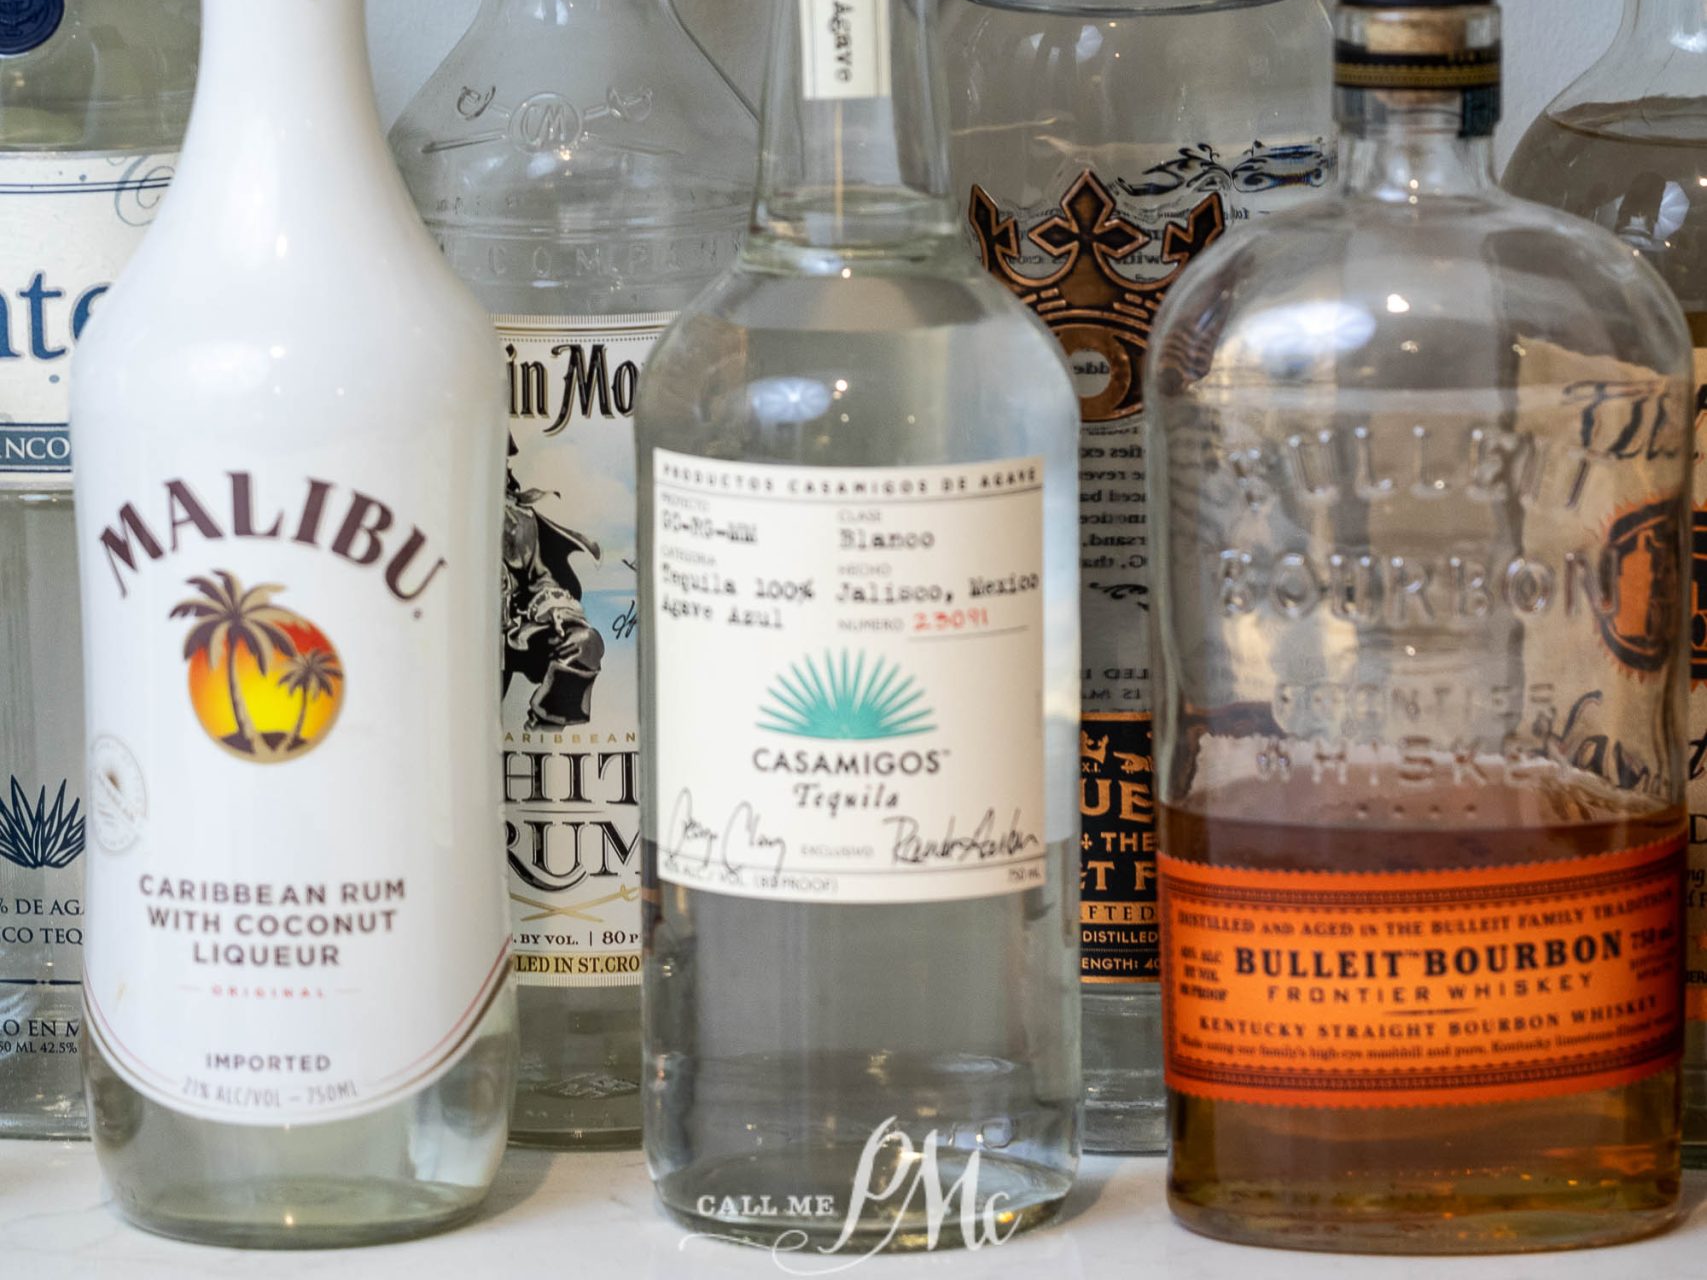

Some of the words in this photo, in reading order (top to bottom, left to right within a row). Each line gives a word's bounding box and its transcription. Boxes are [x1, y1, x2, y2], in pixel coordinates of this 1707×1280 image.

[0, 436, 70, 460] NCO
[787, 479, 928, 498] CASAMIGOS
[940, 475, 966, 493] DE
[98, 469, 449, 602] MALIBU
[839, 528, 936, 550] Blanco
[662, 562, 737, 596] Tequila
[755, 577, 816, 604] 100%
[836, 581, 955, 603] Jalisco,
[968, 572, 1040, 599] Mexico
[1216, 550, 1622, 624] BOURBON
[661, 595, 713, 619] Agave
[913, 607, 989, 632] 23091
[504, 731, 636, 745] ARIBBEAN
[751, 746, 942, 776] CASAMIGOS
[792, 782, 900, 819] Tequila
[1100, 831, 1157, 853] THE
[138, 873, 328, 907] CARIBBEAN
[340, 878, 407, 903] RUM
[15, 898, 44, 916] DE
[49, 898, 85, 916] AG
[1081, 904, 1155, 922] FTED
[146, 906, 222, 935] WITH
[233, 909, 398, 938] COCONUT
[1178, 911, 1255, 934] DISTILLED
[1262, 921, 1295, 935] AND
[1300, 921, 1354, 937] AGED
[1359, 923, 1379, 936] IN
[1385, 920, 1423, 937] THE
[1431, 914, 1512, 935] BULLEIT
[1518, 908, 1585, 930] FAMILY
[39, 927, 84, 946] TEQ
[519, 933, 541, 946] BY
[543, 934, 580, 947] VOL.
[602, 930, 626, 946] 80
[1081, 930, 1159, 944] DISTILLED
[192, 941, 341, 968] LIQUEUR
[516, 955, 551, 974] LED
[553, 956, 574, 974] IN
[1081, 956, 1139, 971] ENGTH:
[1234, 945, 1402, 979] BULLEIT
[1424, 929, 1623, 978] BOURBON
[210, 983, 326, 1000] ORIGINAL
[1266, 985, 1431, 1004] FRONTIER
[1448, 971, 1594, 1001] WHISKEY
[28, 1019, 57, 1038] EN
[1198, 1015, 1307, 1037] KENTUCKY
[1317, 1022, 1436, 1040] STRAIGHT
[1448, 1012, 1561, 1038] BOURBON
[1570, 993, 1658, 1023] WHISKEY
[16, 1040, 37, 1054] ML
[39, 1041, 78, 1055] 42.5%
[205, 1051, 333, 1073] IMPORTED
[181, 1076, 210, 1100] 21%
[214, 1086, 282, 1109] ALC/VOL
[306, 1078, 360, 1106] 750ML
